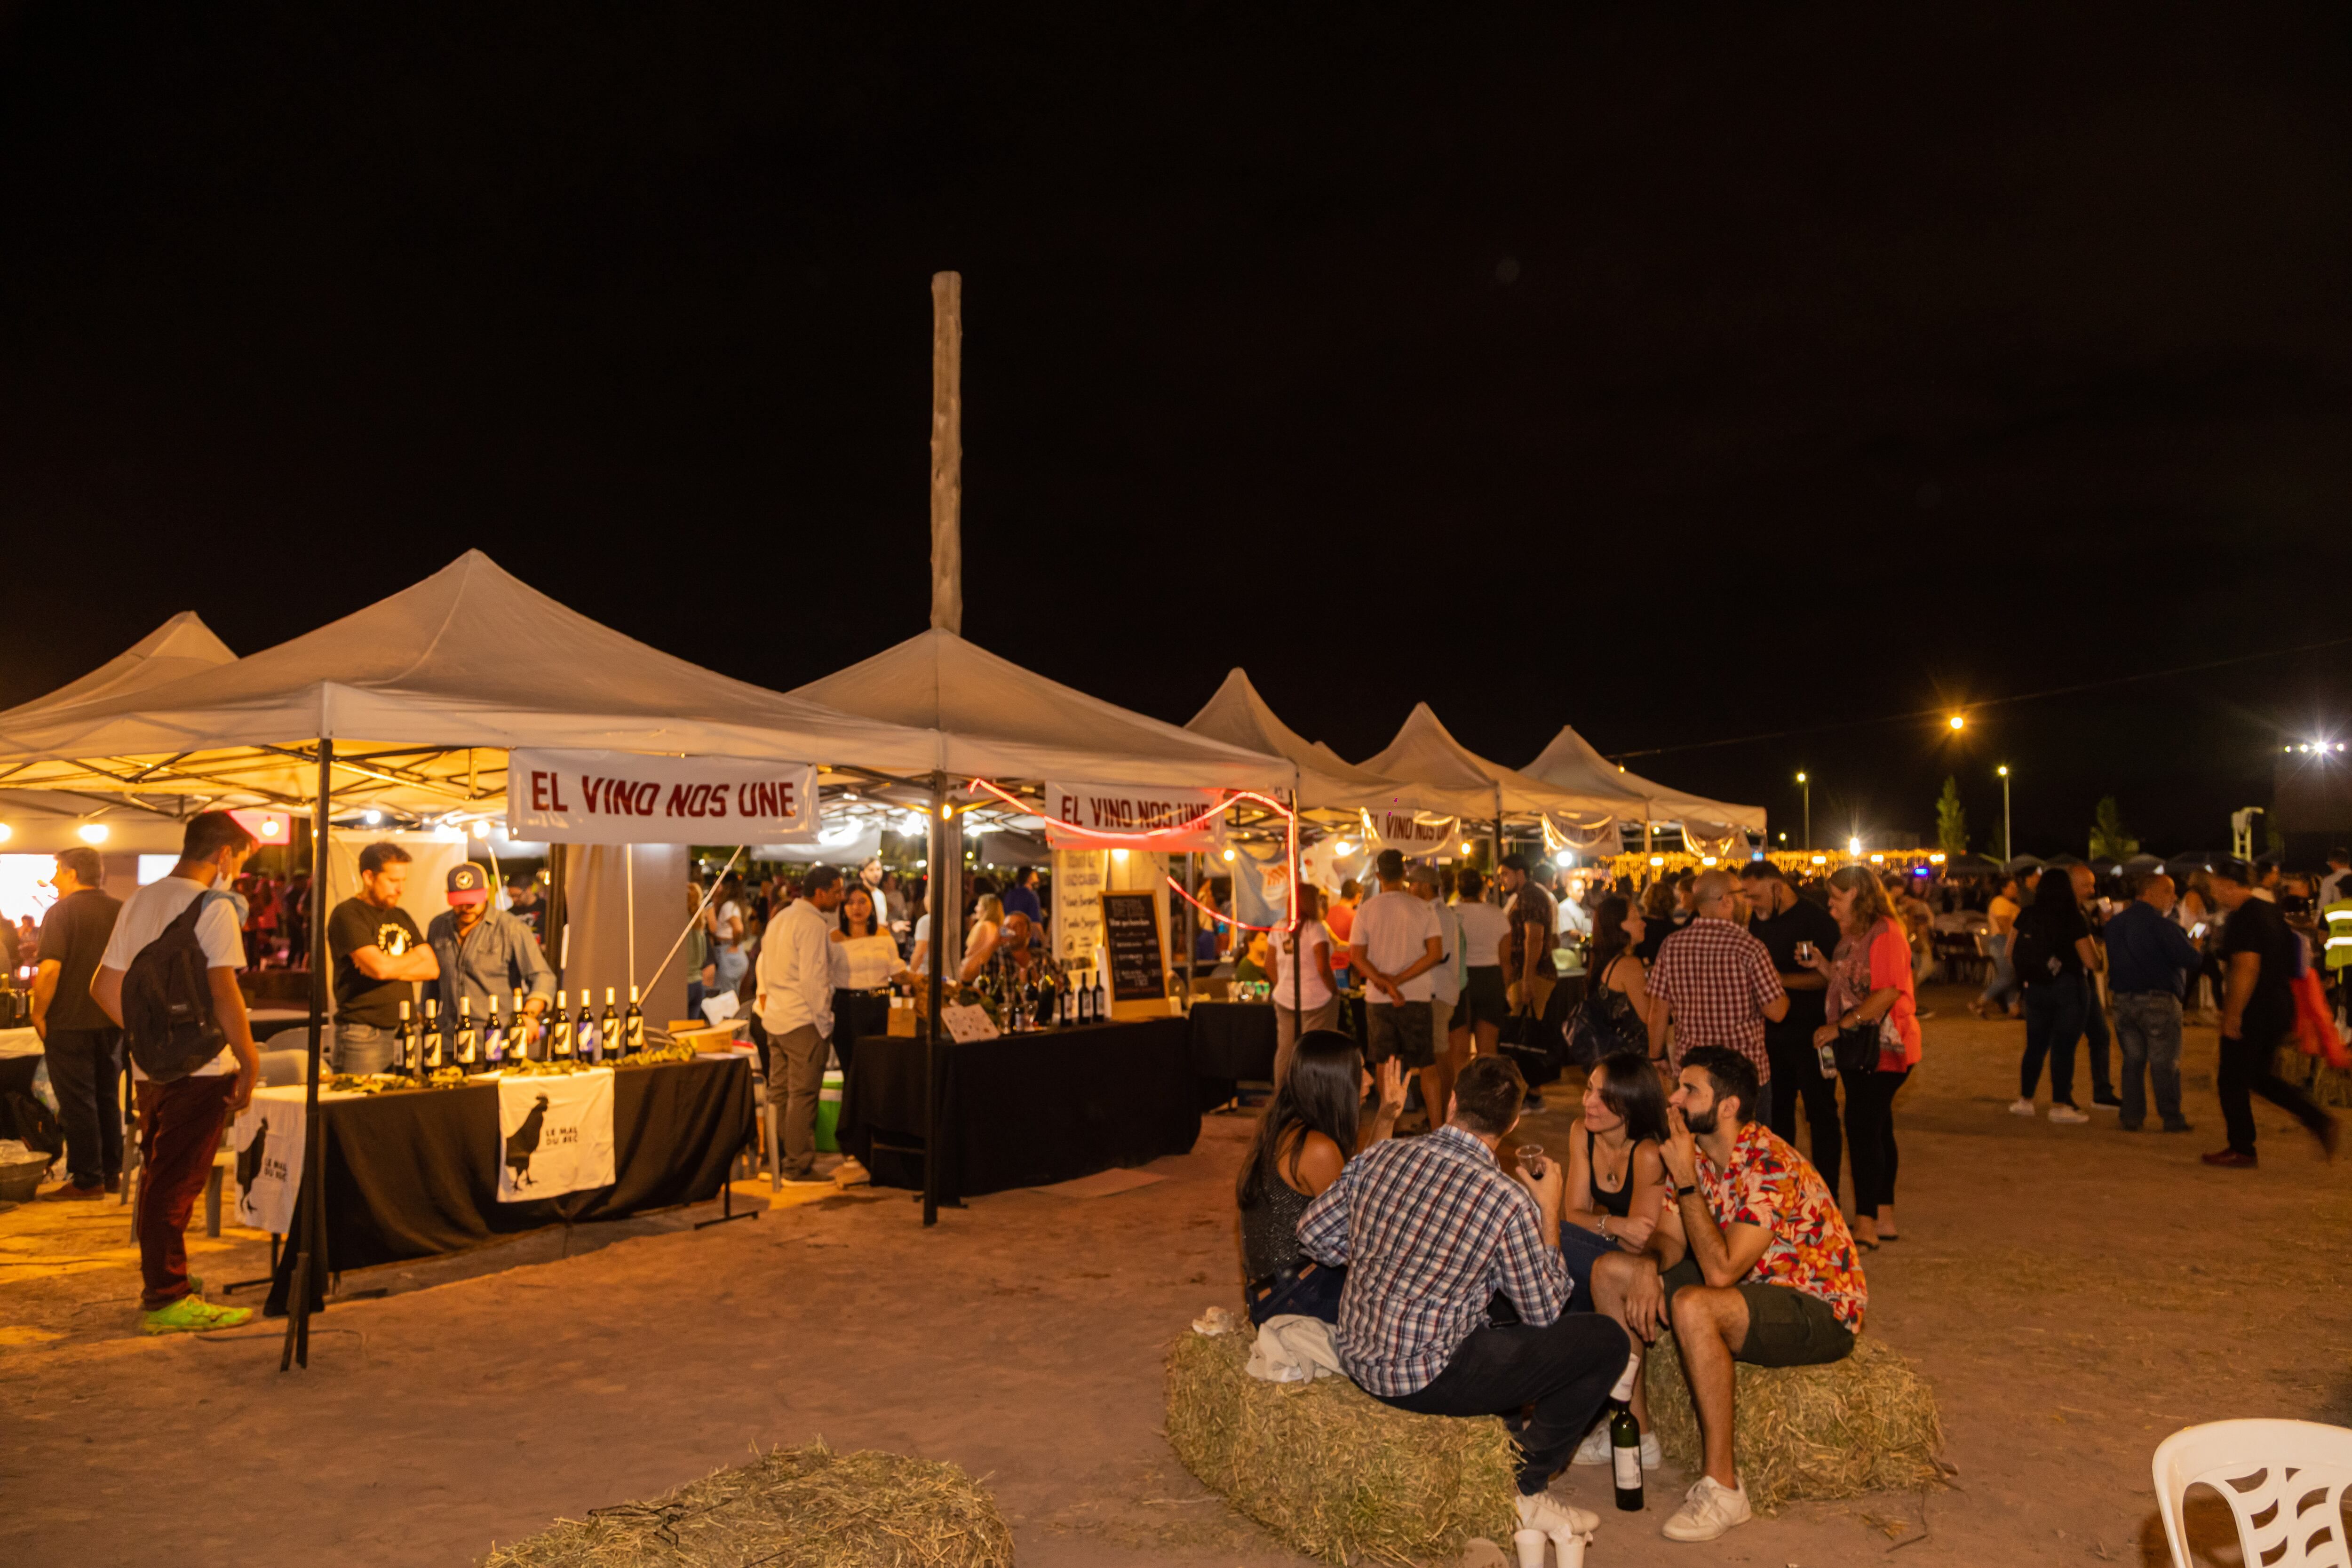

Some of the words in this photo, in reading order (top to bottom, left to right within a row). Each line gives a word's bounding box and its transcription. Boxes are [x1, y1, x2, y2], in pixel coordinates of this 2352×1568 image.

[532, 770, 568, 812] EL
[582, 774, 660, 816] VINO
[666, 783, 730, 817] NOS
[738, 781, 796, 817] UNE
[1061, 795, 1083, 826] EL
[1090, 796, 1133, 828] VINO
[1137, 801, 1172, 828] NOS
[1177, 803, 1211, 830] UNE
[1387, 816, 1412, 839] VINO
